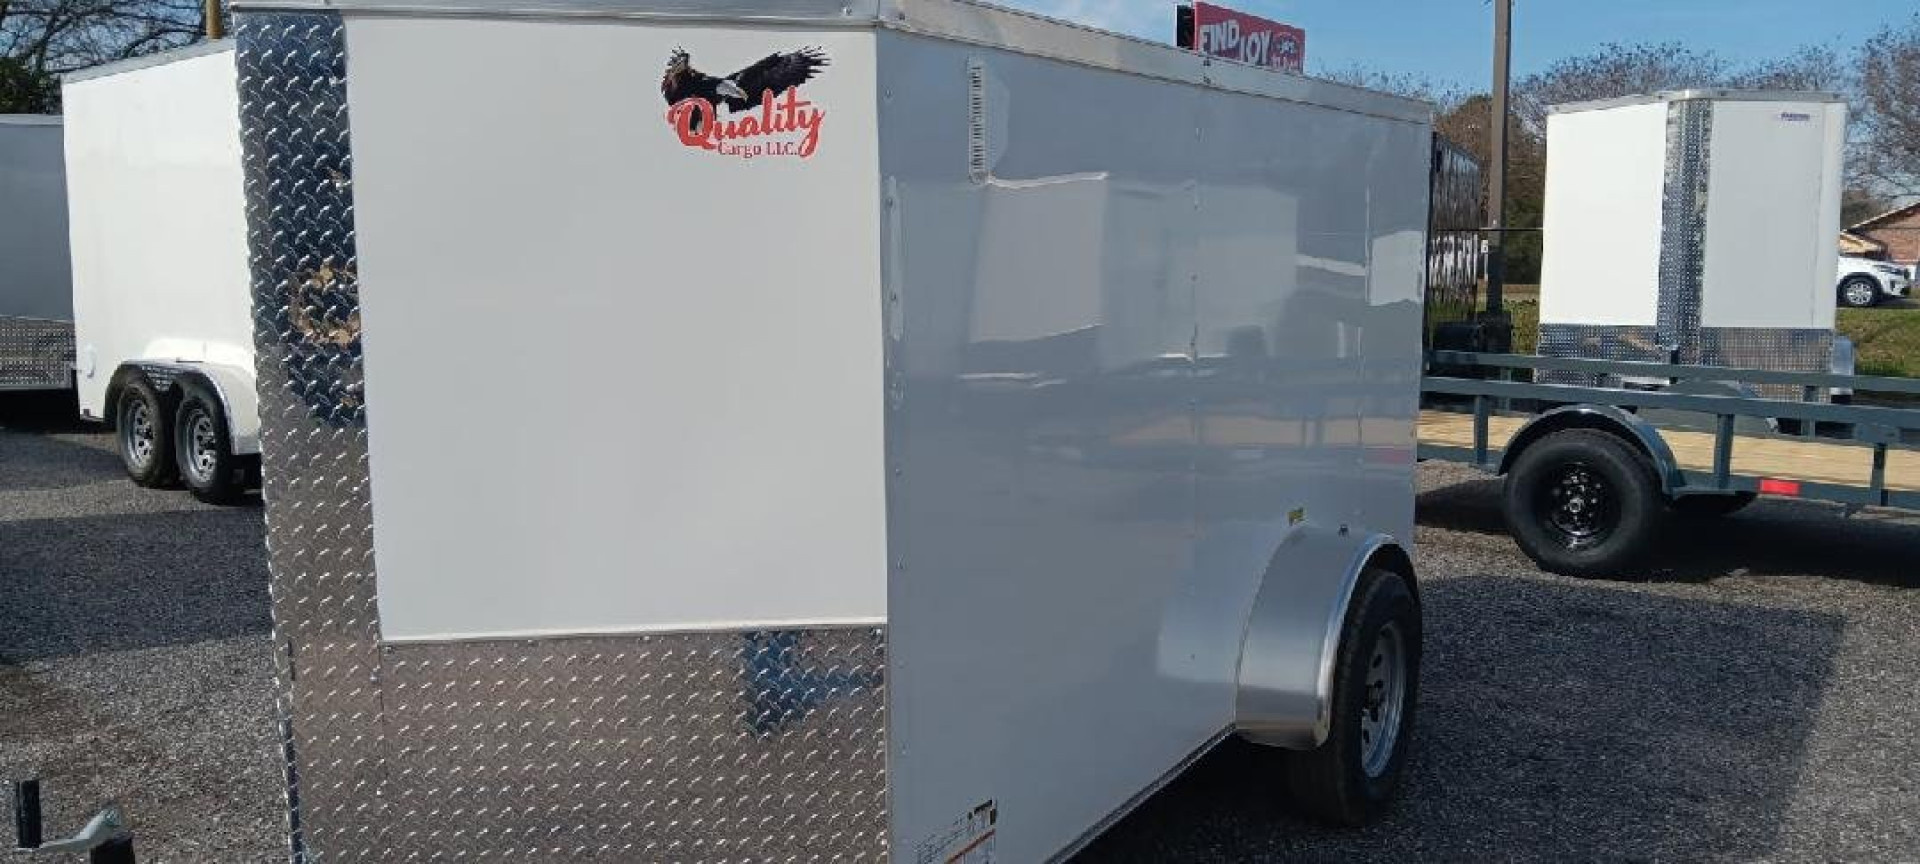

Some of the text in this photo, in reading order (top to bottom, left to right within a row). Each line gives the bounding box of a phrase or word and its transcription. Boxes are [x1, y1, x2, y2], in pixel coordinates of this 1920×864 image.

[1199, 19, 1240, 54] FIND
[667, 85, 825, 158] Quality
[718, 142, 762, 159] Cargo
